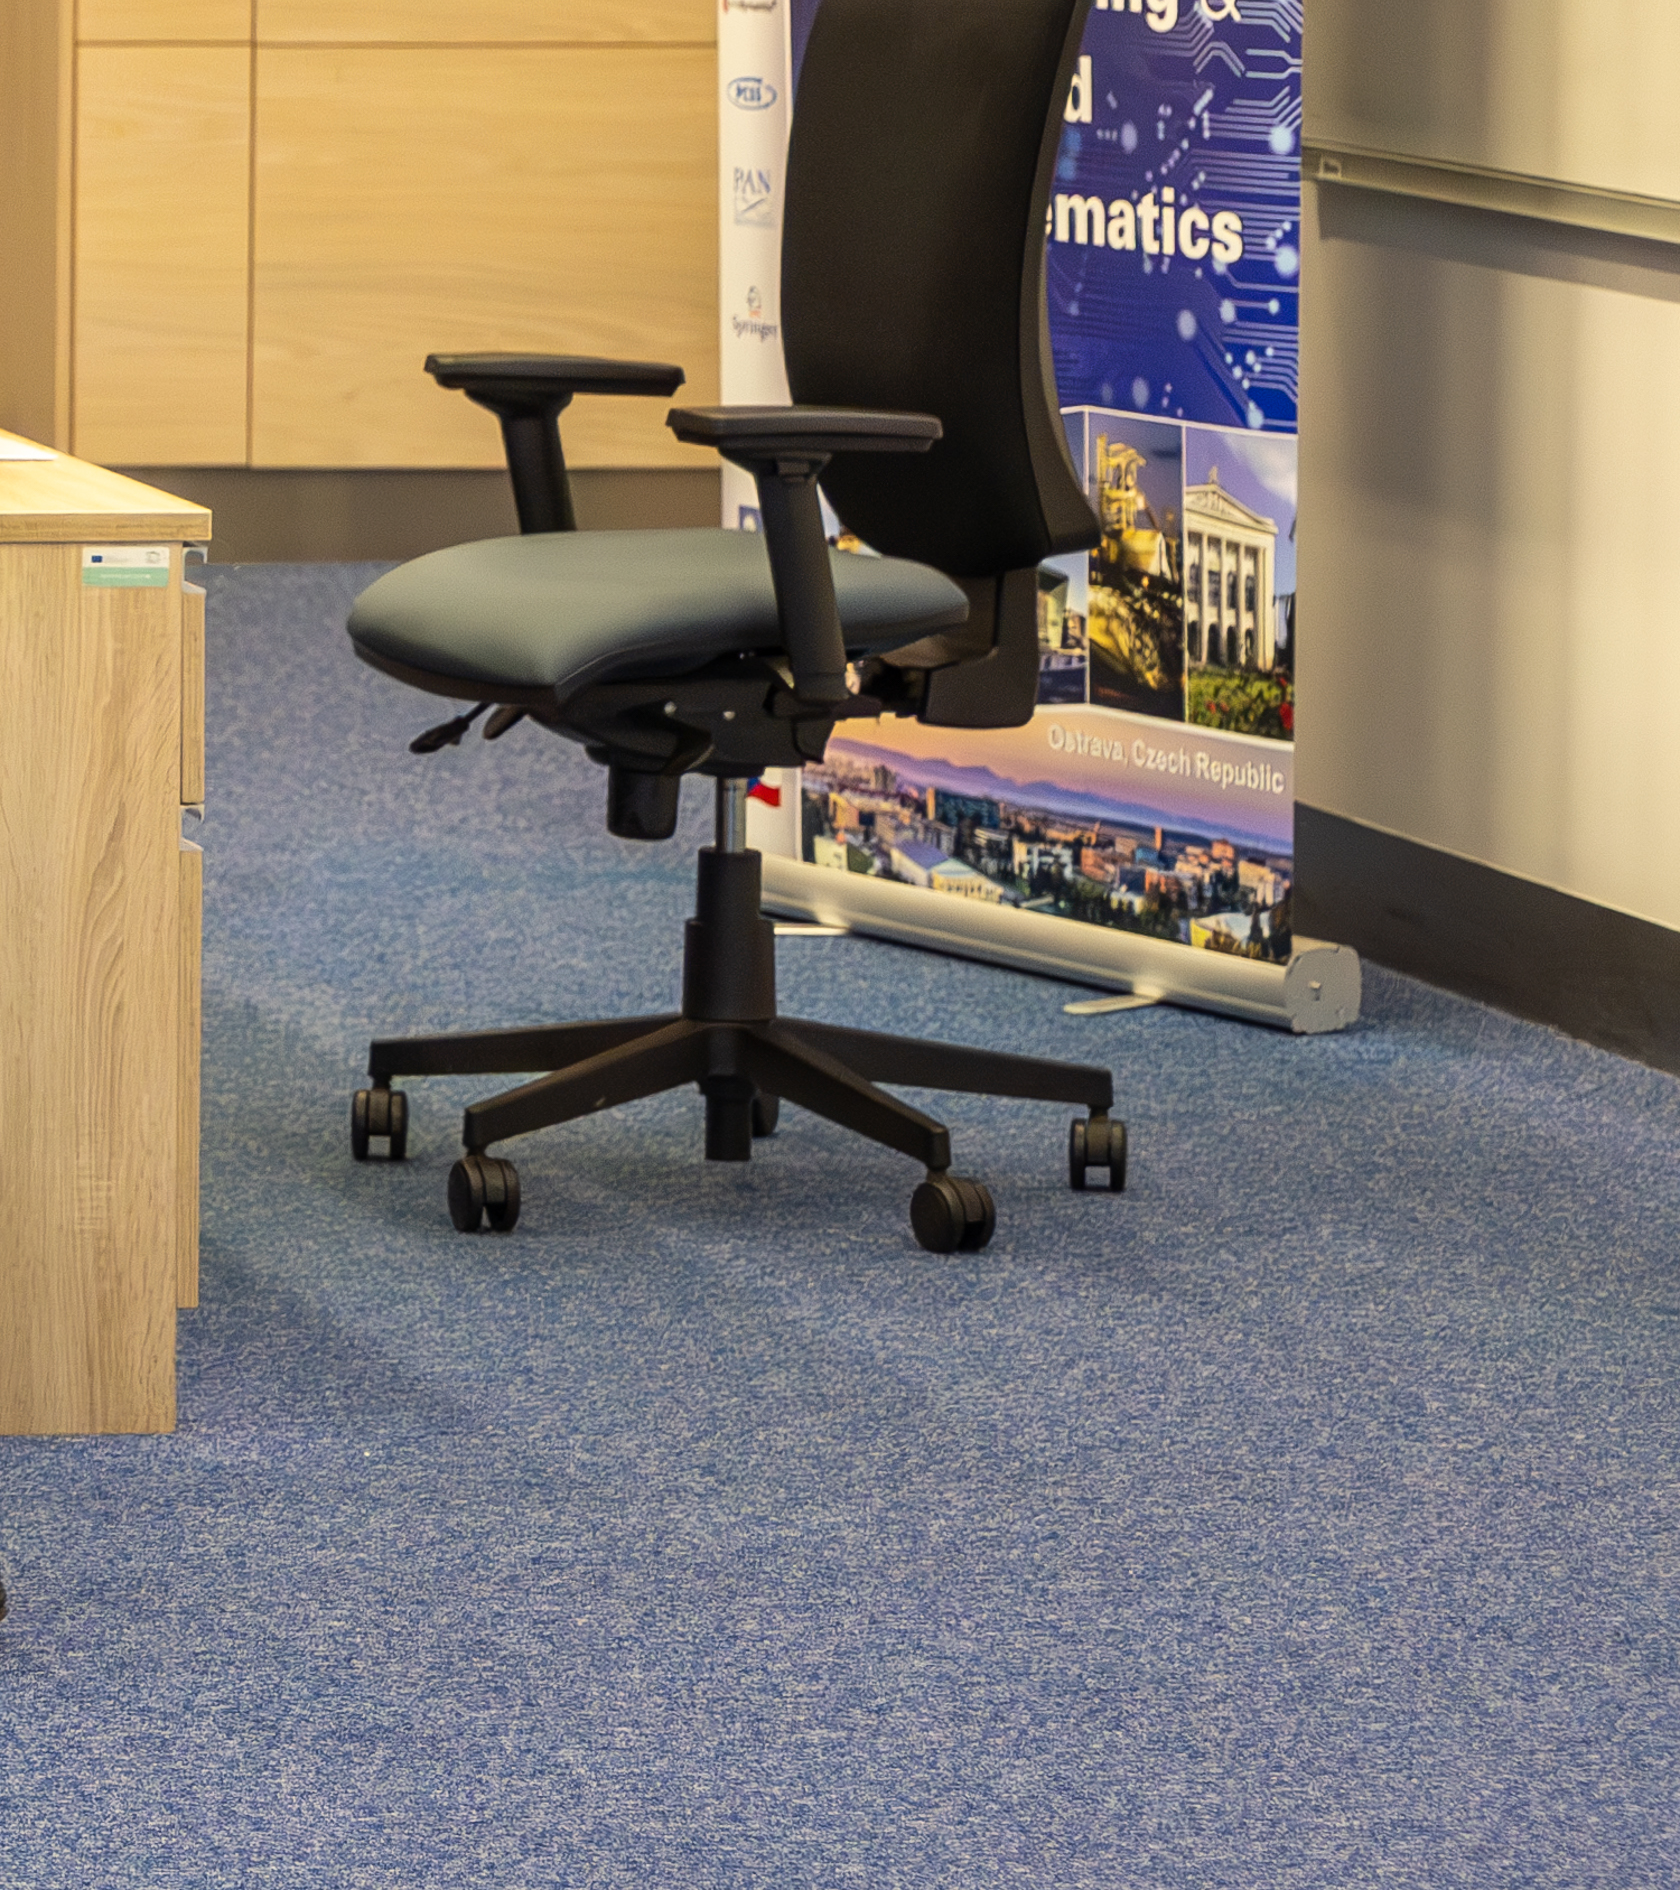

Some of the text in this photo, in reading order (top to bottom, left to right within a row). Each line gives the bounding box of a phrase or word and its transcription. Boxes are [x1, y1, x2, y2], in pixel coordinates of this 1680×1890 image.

[1045, 185, 1244, 264] matics
[1048, 724, 1285, 794] Ostrava, Czech Republic
